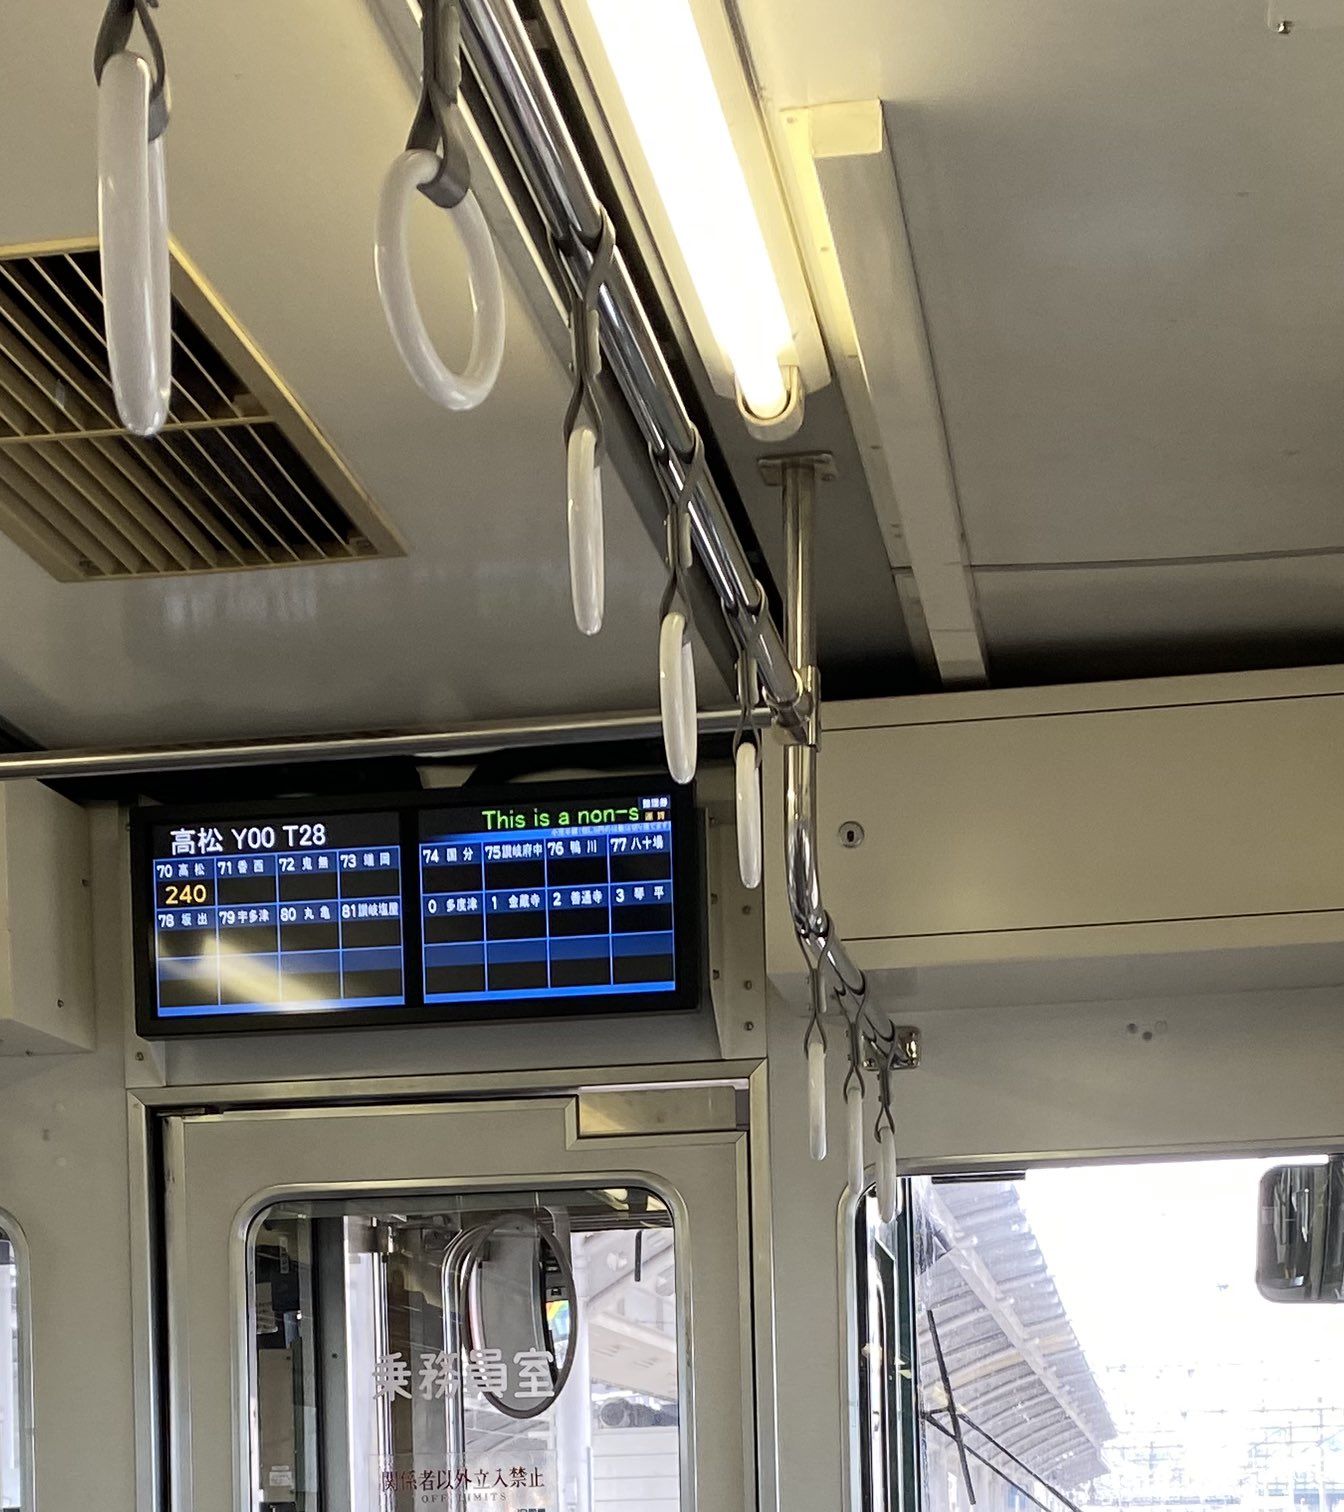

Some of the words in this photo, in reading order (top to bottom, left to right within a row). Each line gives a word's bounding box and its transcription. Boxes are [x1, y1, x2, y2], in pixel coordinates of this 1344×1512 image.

[482, 810, 526, 830] This
[534, 808, 550, 827] is
[558, 811, 570, 825] a
[578, 807, 639, 824] non-s
[170, 827, 224, 856] 高松
[231, 826, 276, 850] Y00
[282, 823, 326, 847] T28
[423, 849, 439, 863] 74
[485, 846, 501, 860] 75
[547, 842, 564, 856] 76
[611, 838, 627, 852] 77
[157, 864, 173, 879] 70
[178, 863, 205, 877] 高松
[217, 861, 232, 875] 71
[279, 857, 295, 872] 72
[340, 854, 357, 868] 73
[165, 884, 207, 905] 240
[428, 899, 437, 913] 0
[492, 896, 497, 910] 1
[553, 892, 562, 906] 2
[615, 889, 625, 903] 3
[158, 913, 174, 928] 78
[219, 911, 235, 925] 79
[280, 907, 297, 922] 80
[342, 904, 357, 919] 81
[371, 1347, 556, 1401] 乗務員室
[382, 1466, 545, 1491] 関係者以外立入禁止
